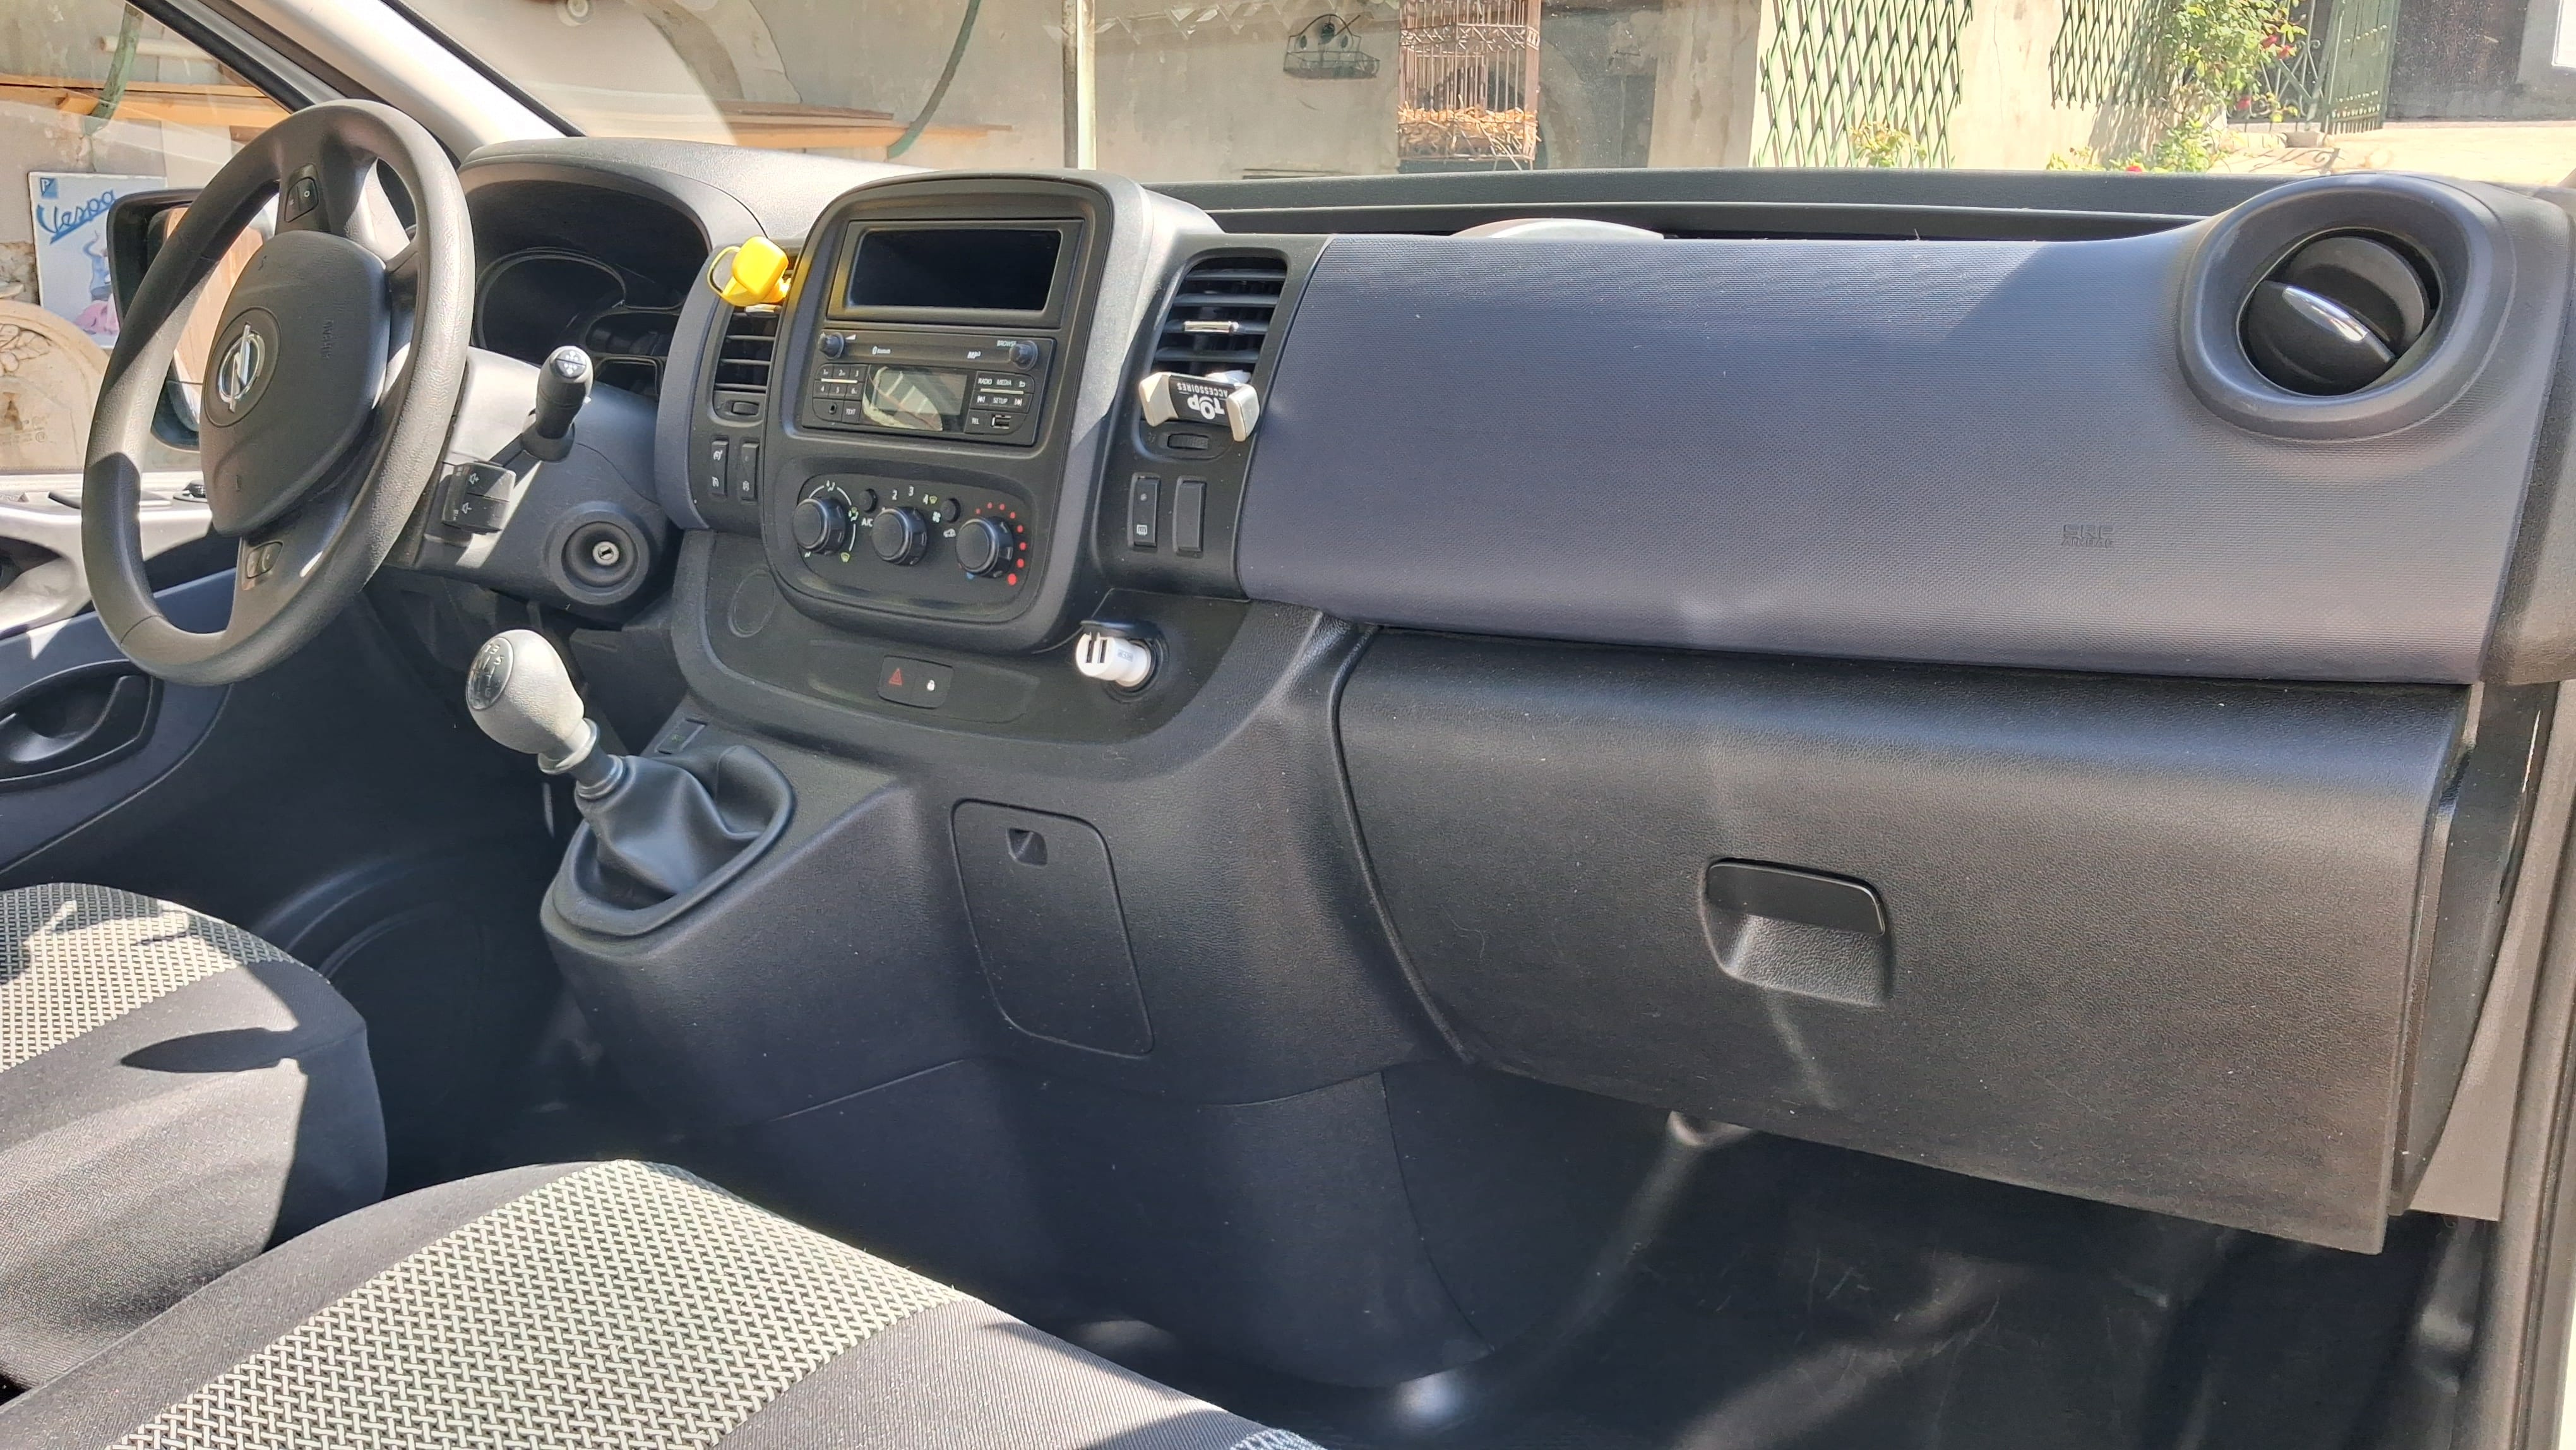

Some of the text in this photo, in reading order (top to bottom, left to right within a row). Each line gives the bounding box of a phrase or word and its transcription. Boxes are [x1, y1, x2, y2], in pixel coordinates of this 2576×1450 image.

[36, 189, 116, 245] Vespa
[967, 351, 981, 359] MP3
[1176, 382, 1228, 398] ACCESSOIRES
[993, 397, 1008, 405] SETUP
[1187, 394, 1225, 420] TOP
[891, 489, 897, 500] 2
[909, 485, 914, 496] 3
[922, 494, 929, 505] 4
[861, 518, 873, 527] A/C
